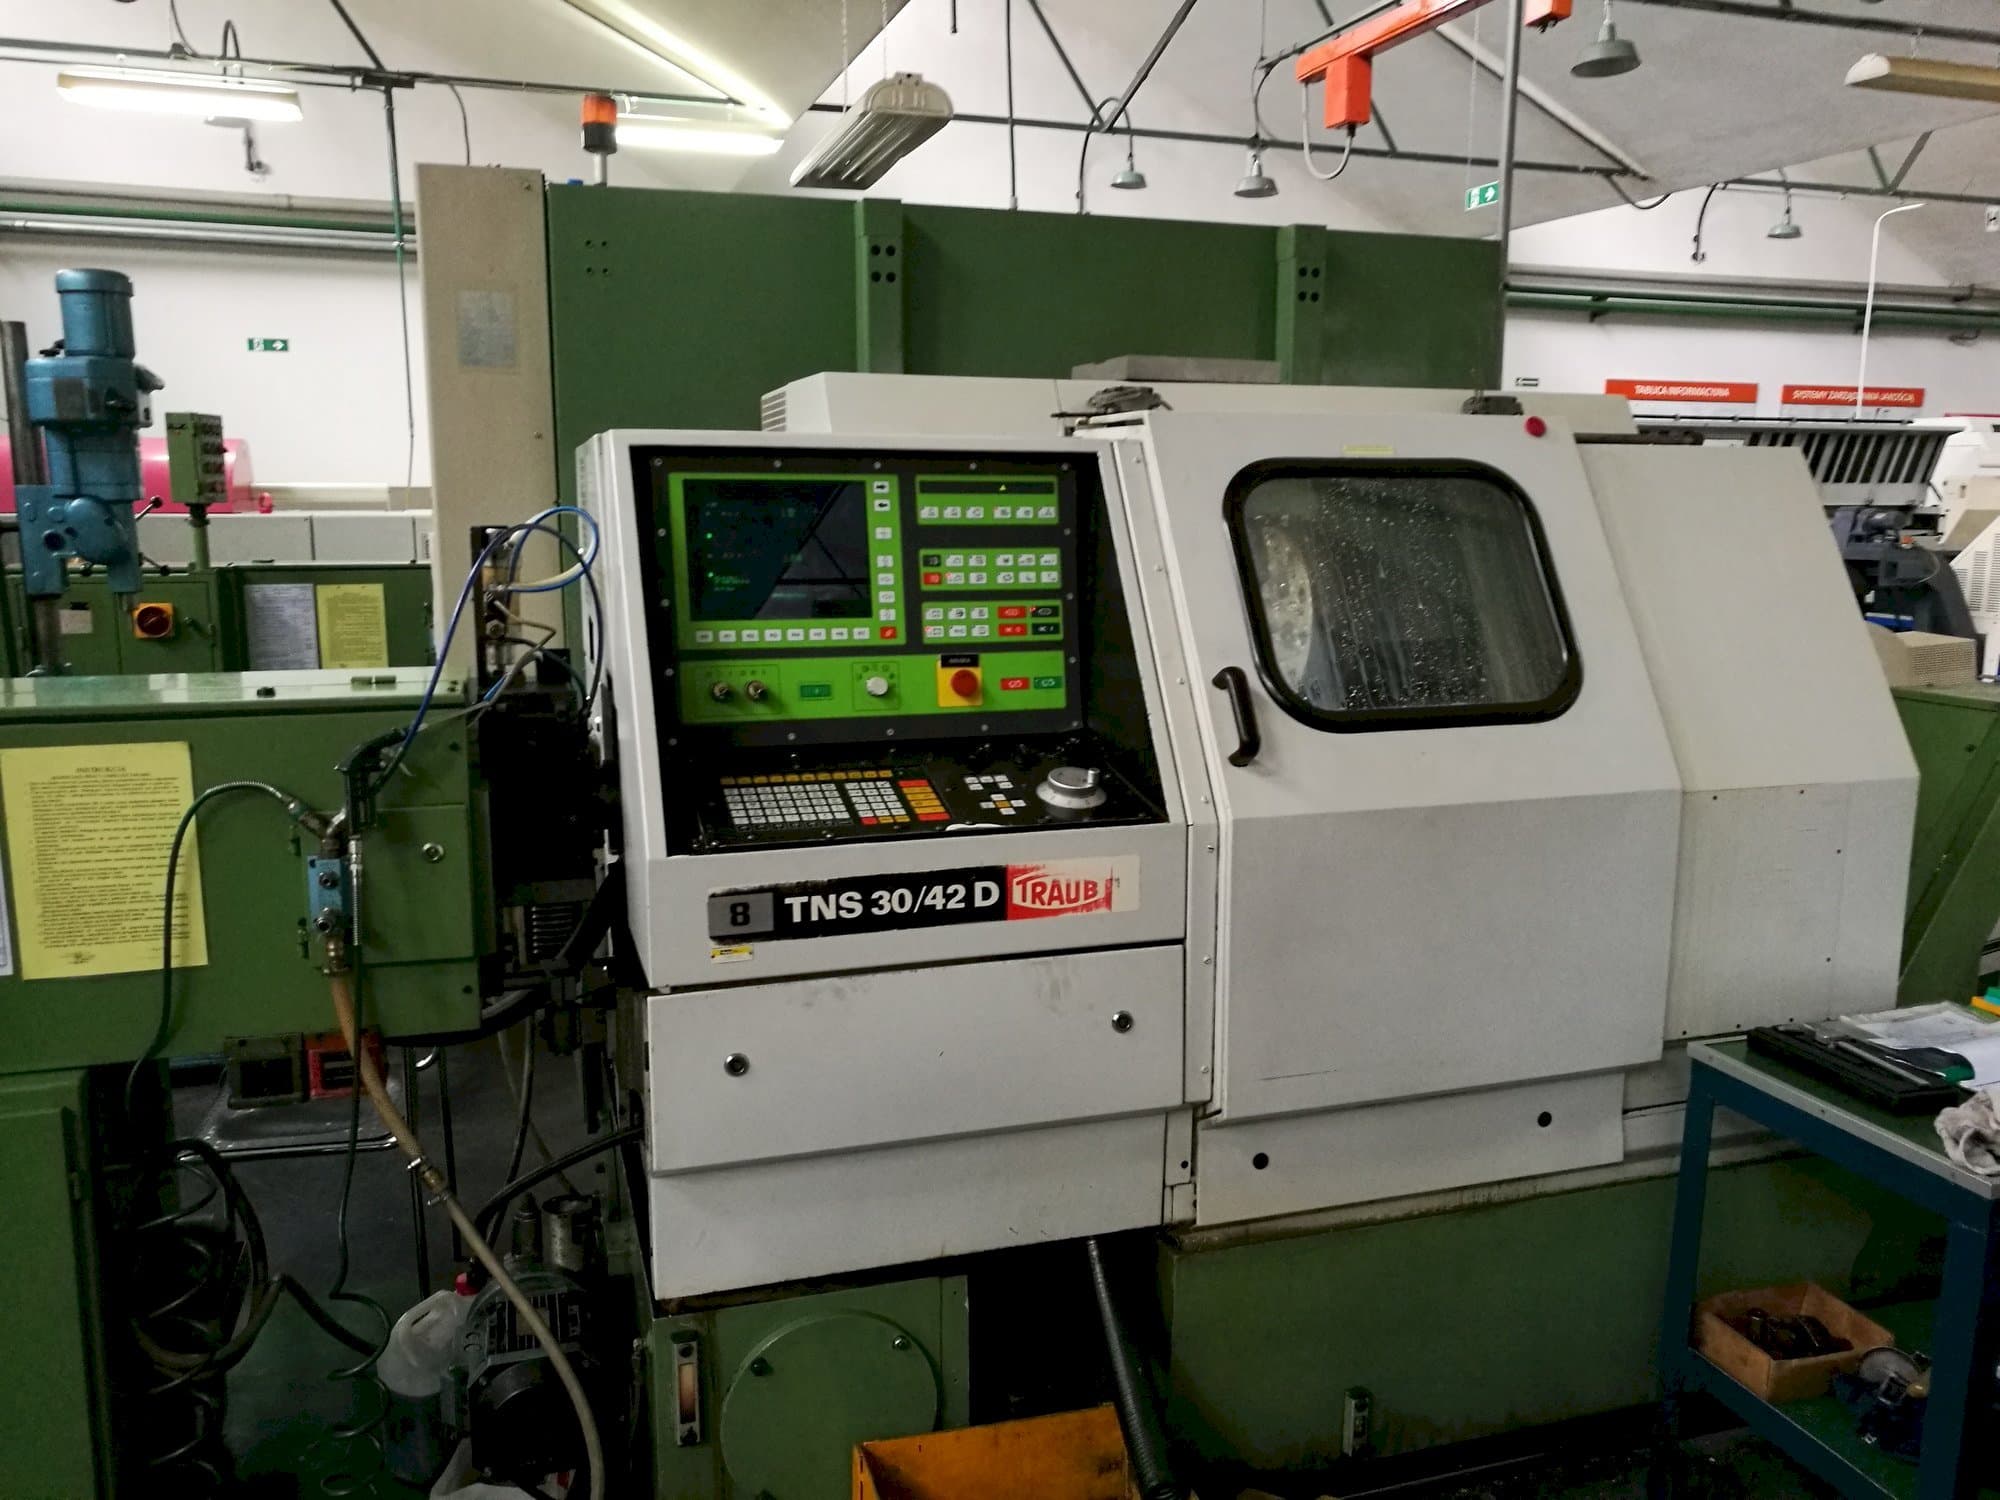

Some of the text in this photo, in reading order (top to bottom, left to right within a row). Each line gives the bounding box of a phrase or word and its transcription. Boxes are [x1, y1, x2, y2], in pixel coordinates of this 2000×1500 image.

[784, 881, 1000, 923] TNS 30/42 D
[1015, 873, 1099, 907] TRAUB
[729, 902, 750, 926] 8
